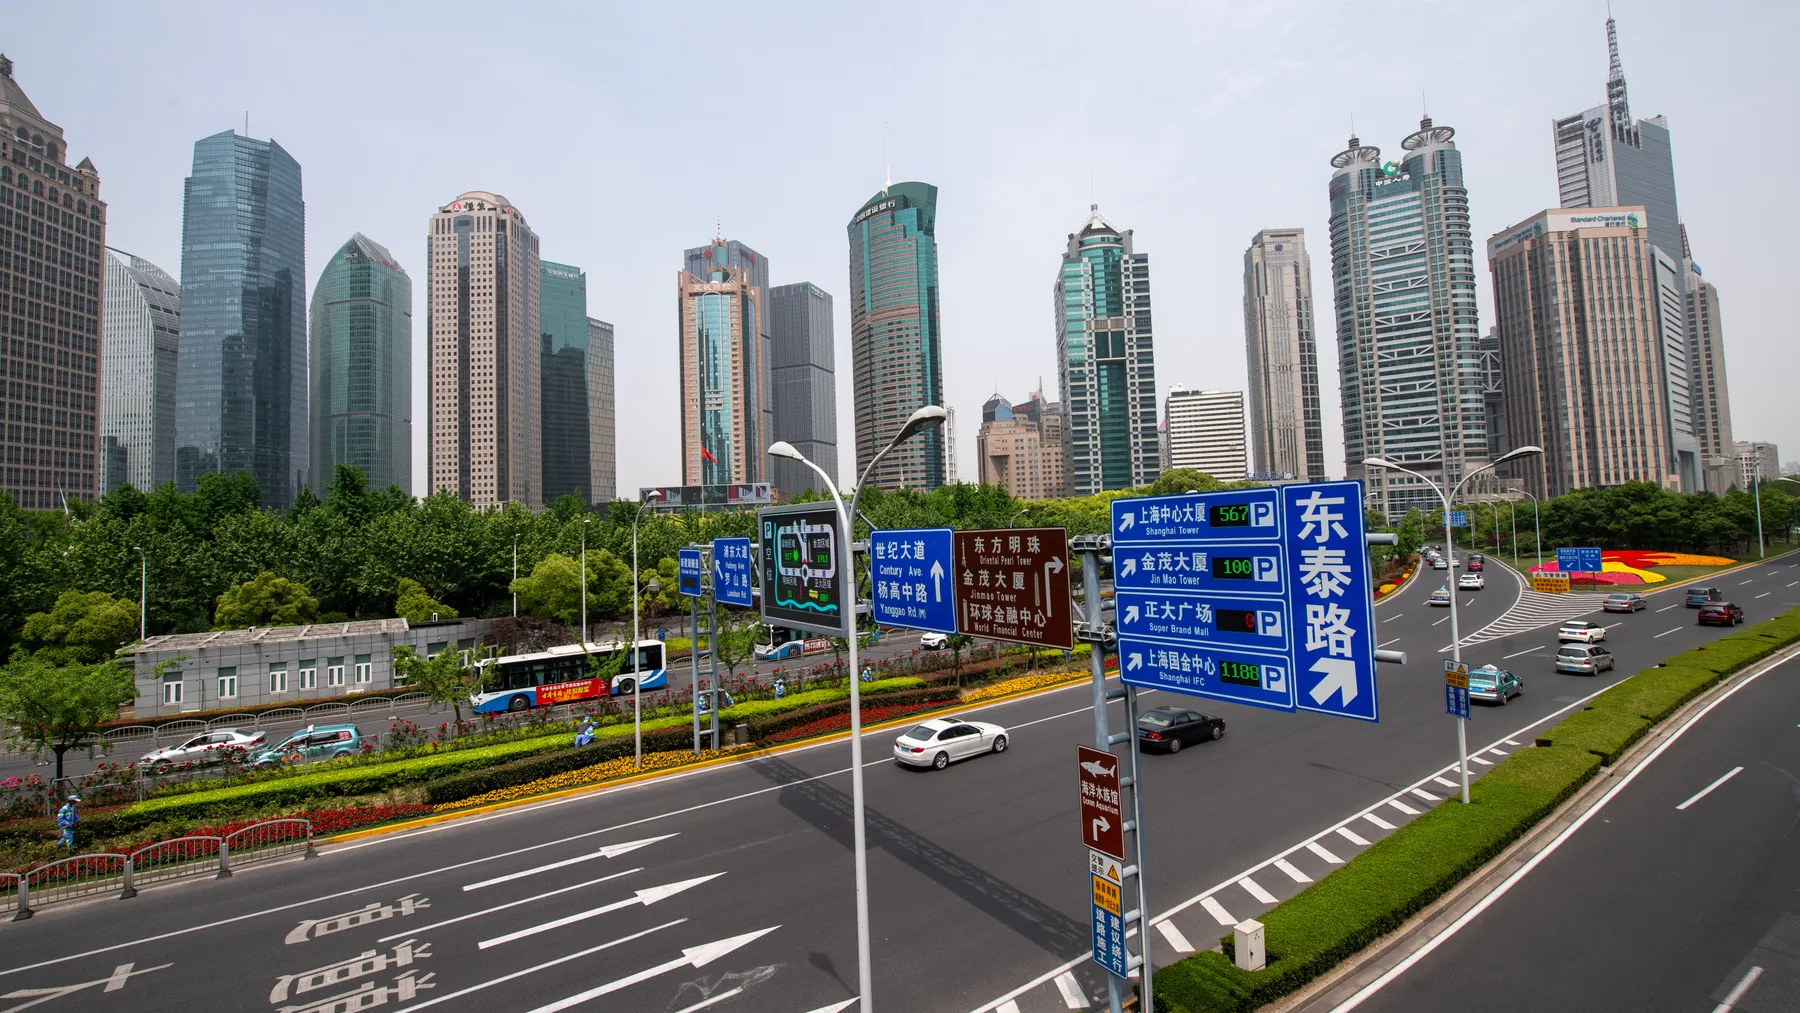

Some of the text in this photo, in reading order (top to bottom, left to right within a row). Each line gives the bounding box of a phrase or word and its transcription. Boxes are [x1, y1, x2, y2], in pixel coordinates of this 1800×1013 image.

[1375, 174, 1410, 187] 中国人寿
[463, 200, 485, 211] 恒生
[1139, 502, 1270, 526] 上海中心大厦 567 P
[765, 523, 771, 537] P
[1146, 526, 1199, 537] Shanghai Tower
[723, 545, 748, 559] 浦东大道
[876, 540, 925, 560] 世纪大道
[974, 535, 1041, 554] 东方明珠
[765, 547, 773, 581] 空位
[980, 555, 1032, 566] Oriental Pearl Tower
[1141, 552, 1273, 581] 金茂大厦 100 P
[724, 572, 748, 588] 罗山路
[879, 564, 924, 578] Century Ave.
[963, 568, 1026, 591] 金茂大厦
[1150, 574, 1200, 585] Jin Mao Tower
[1296, 491, 1356, 657] 东泰路
[877, 581, 928, 604] 杨高中路
[970, 589, 1017, 602] Jinmao Tower
[880, 603, 906, 618] Yanggao
[969, 603, 1047, 628] 环球金融中心
[1145, 601, 1278, 634] 正大广场 0 P
[974, 621, 1043, 639] World Financial Center
[1149, 622, 1209, 637] Super Brand Mall
[1148, 649, 1282, 690] 上海国金中心 1188 P
[1159, 671, 1205, 686] Shanghai IFC
[1081, 780, 1119, 806] 海洋水族馆
[1082, 796, 1119, 816] Ocean Aquarium
[1091, 853, 1104, 867] 交警
[1095, 907, 1108, 964] 道路施工
[1110, 915, 1123, 973] 建议绕行
